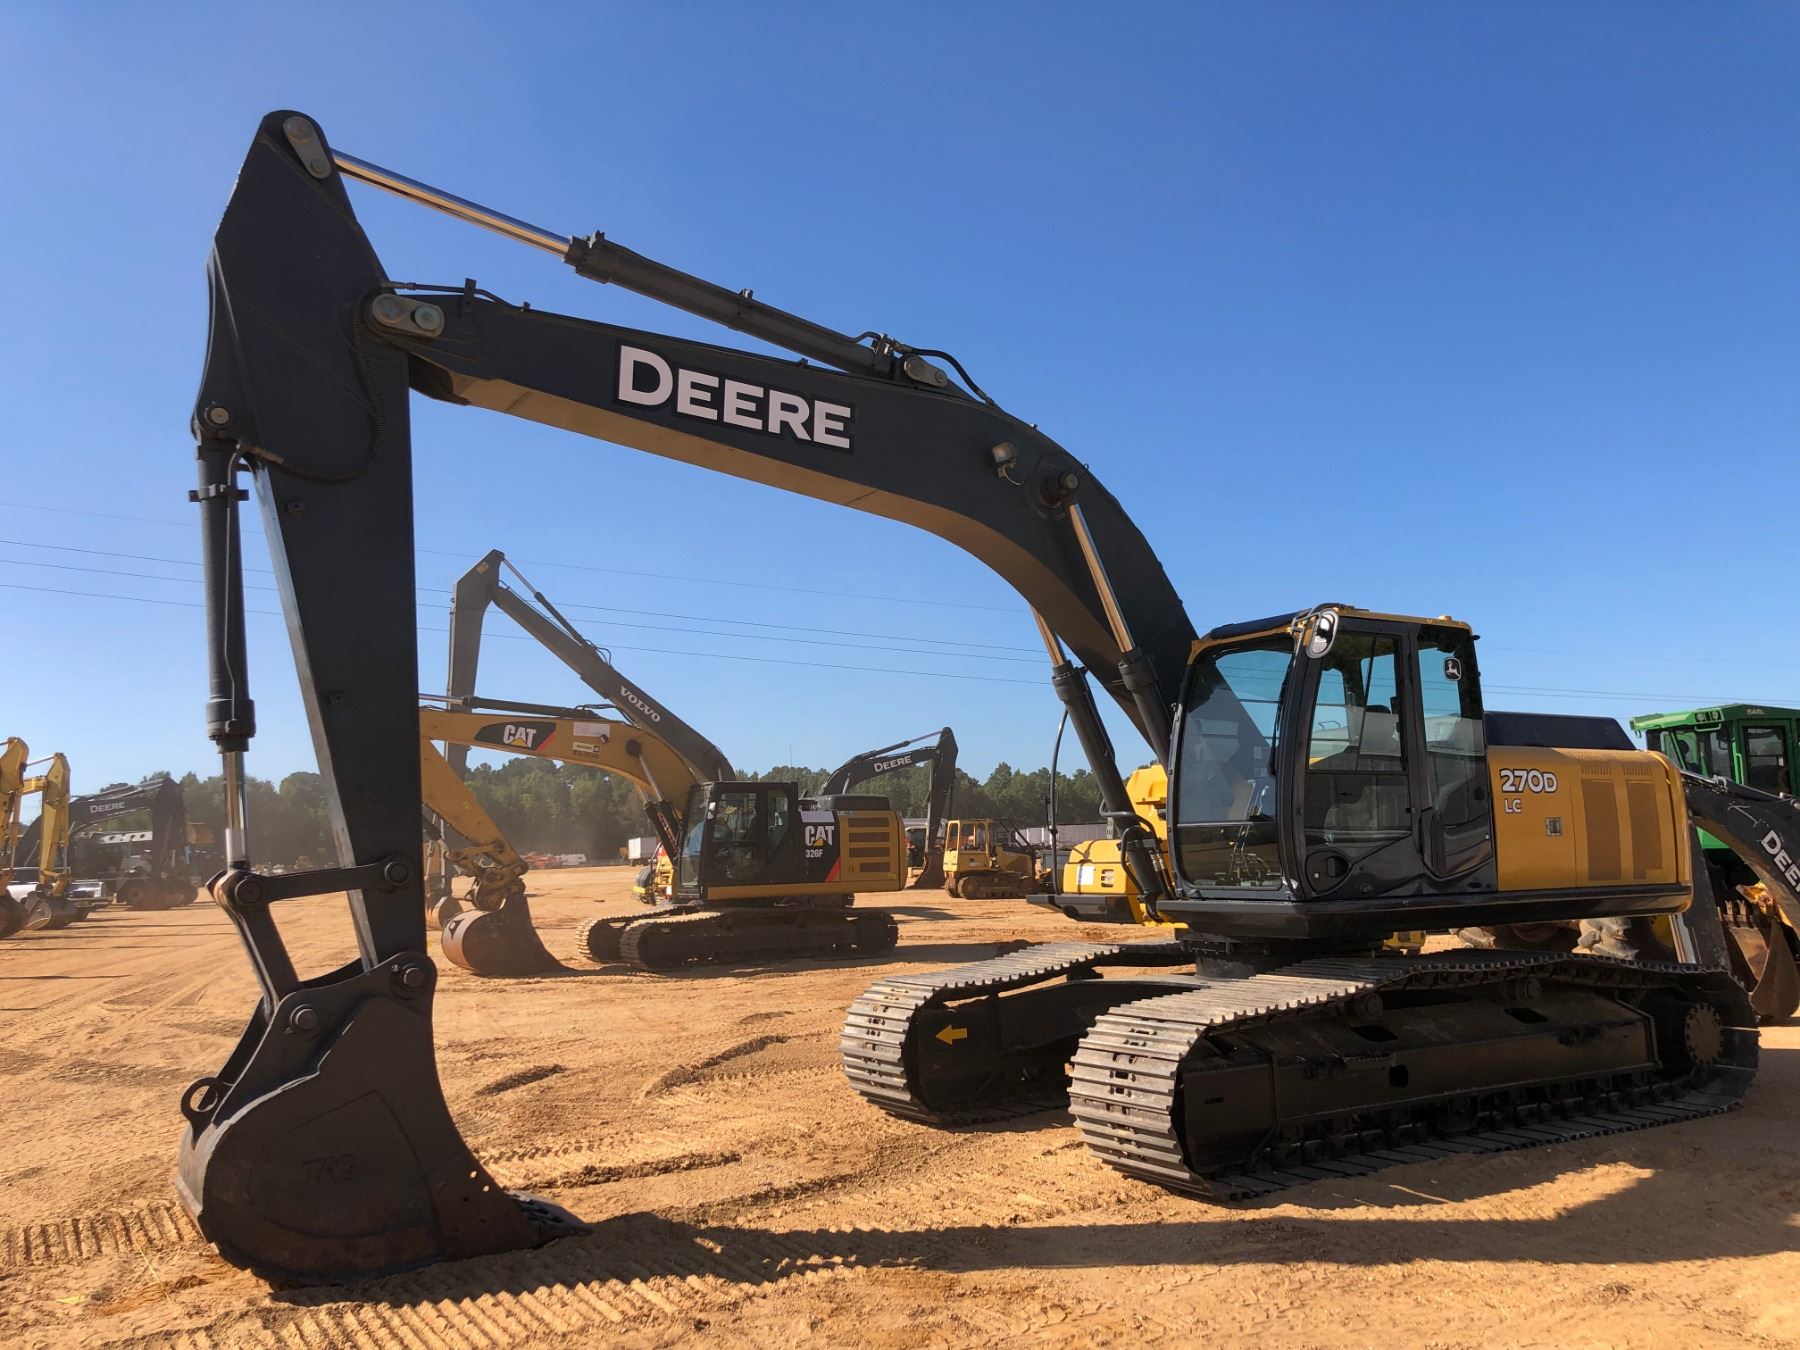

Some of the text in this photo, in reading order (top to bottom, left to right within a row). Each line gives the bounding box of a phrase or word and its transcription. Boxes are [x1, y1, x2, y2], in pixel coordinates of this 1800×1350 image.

[618, 345, 851, 449] DEERE
[620, 684, 661, 722] VOLVO
[503, 724, 537, 749] CAT
[873, 755, 913, 773] DEERE
[1499, 768, 1558, 794] 270D
[90, 801, 127, 814] DEERE
[1504, 798, 1522, 814] LC
[804, 825, 835, 847] CAT
[805, 849, 824, 858] 326F
[1760, 829, 1800, 894] DEE
